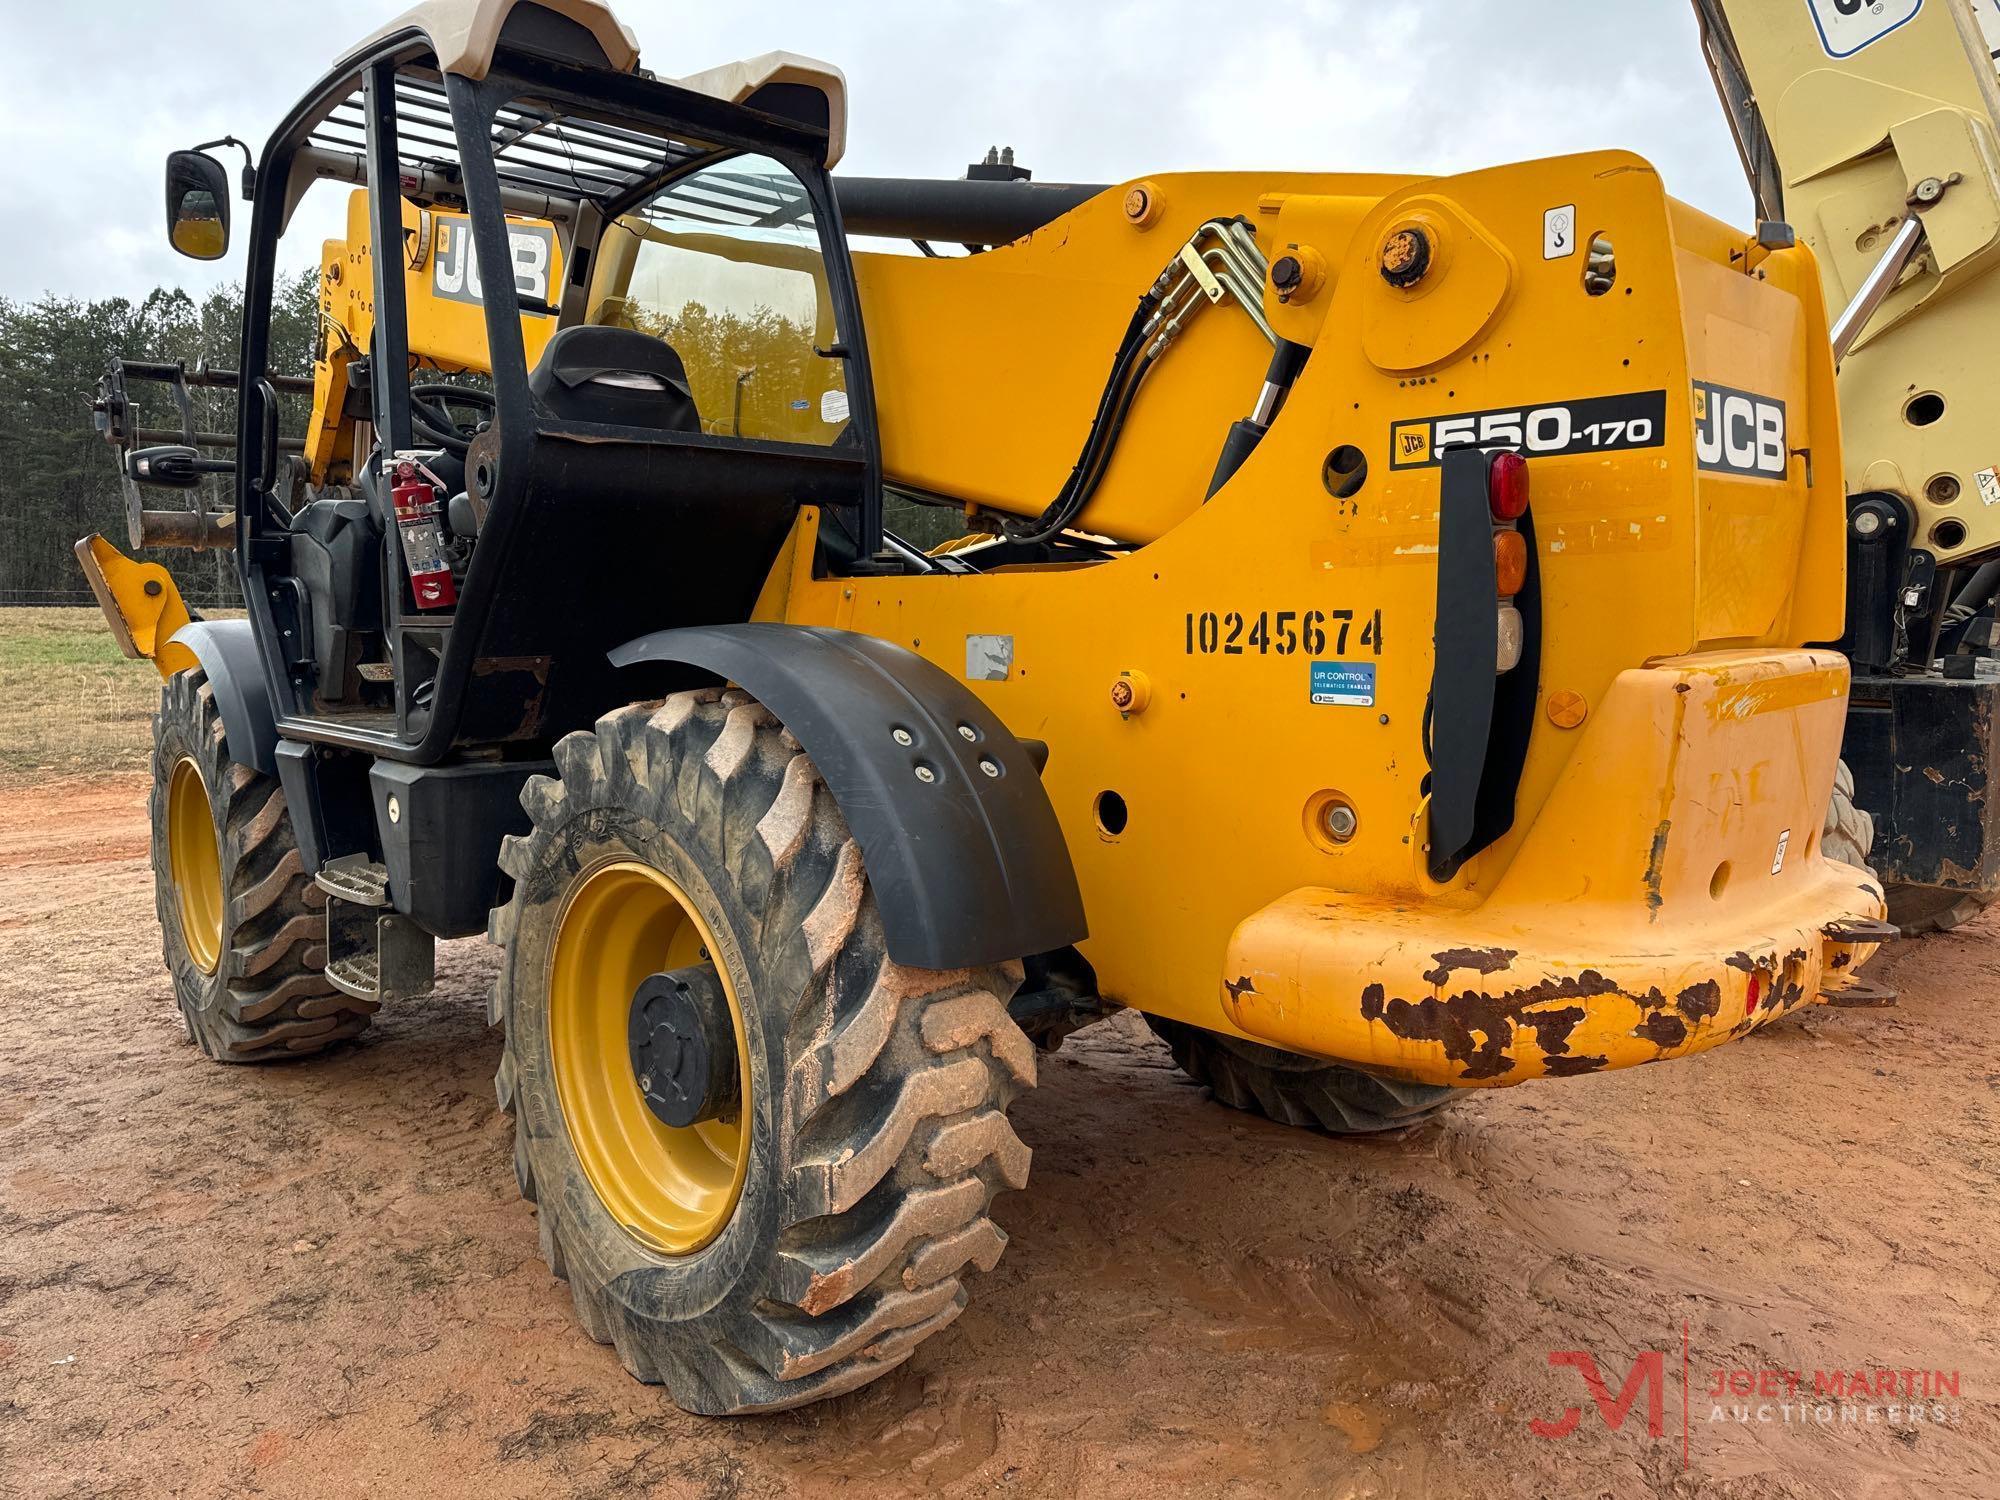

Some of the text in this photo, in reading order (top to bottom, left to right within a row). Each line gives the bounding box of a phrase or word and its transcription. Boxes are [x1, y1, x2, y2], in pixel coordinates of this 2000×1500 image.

[1404, 435, 1424, 453] JCB
[1434, 407, 1652, 460] 550-170
[1696, 392, 1785, 472] JCB
[1186, 608, 1384, 655] 10245674
[1314, 672, 1366, 681] UR CONTROL
